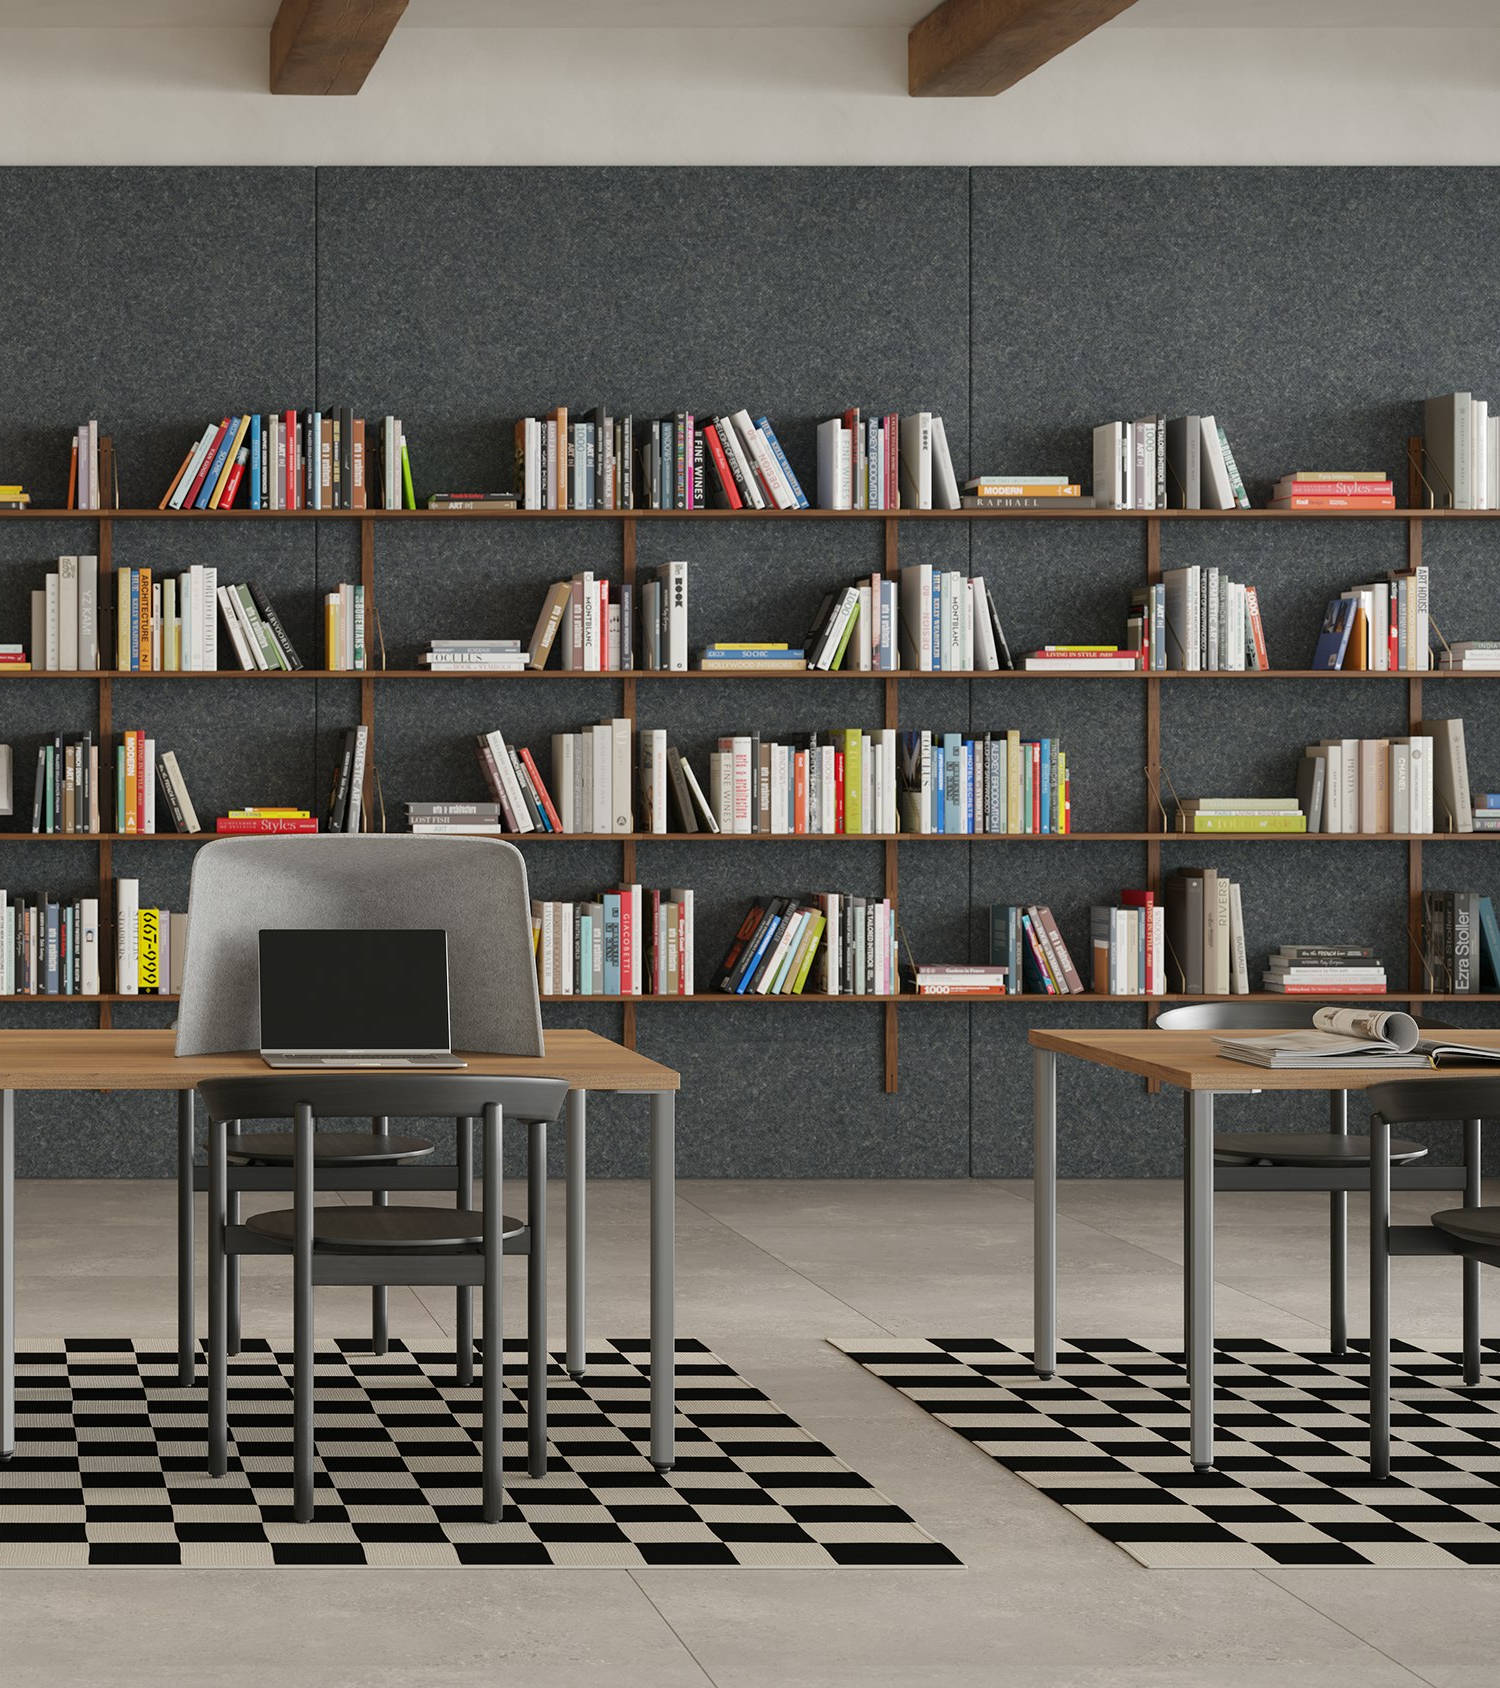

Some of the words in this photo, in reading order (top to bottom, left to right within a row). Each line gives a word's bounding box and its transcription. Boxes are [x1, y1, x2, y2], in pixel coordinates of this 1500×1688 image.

[576, 427, 585, 452] 1000
[869, 419, 877, 450] ALEXEY
[1146, 427, 1155, 453] 1000
[278, 443, 286, 458] ART
[695, 440, 703, 463] FINE
[842, 440, 850, 465] FINE
[1136, 442, 1144, 457] ART
[758, 452, 781, 490] DESIGN
[1223, 444, 1243, 488] BOHEMIANS
[695, 466, 703, 500] WINES
[842, 466, 850, 499] WINES
[984, 486, 1023, 495] MODERN
[1336, 482, 1371, 497] Styles
[977, 498, 1040, 507] RAPHAEL
[1418, 569, 1427, 586] ART
[675, 577, 683, 608] BOOK
[841, 591, 857, 616] 1000
[1209, 573, 1217, 623] DOMESTIC
[1247, 591, 1258, 616] 1000
[1418, 586, 1427, 614] HOUSE
[82, 607, 92, 636] KAMI
[141, 574, 149, 642] ARCHITECTURE
[1157, 603, 1165, 617] ART
[264, 606, 292, 655] VERVOORDT
[355, 604, 364, 649] BOHEMIANS
[922, 612, 930, 651] DESIGN
[1209, 625, 1217, 644] ART
[435, 654, 483, 663] OCULUS
[126, 738, 134, 777] MODERN
[355, 731, 366, 784] DOMESTIC
[66, 766, 74, 781] ART
[724, 764, 732, 787] FINE
[1347, 758, 1355, 794] PRADA
[353, 786, 362, 805] ART
[724, 790, 732, 823] WINES
[261, 819, 296, 831] Styles
[1219, 881, 1227, 927] RIVERS
[545, 934, 552, 945] ON
[1454, 909, 1470, 956] Stoller
[143, 912, 157, 984] 667-999
[1236, 936, 1245, 975] BAUHAUS
[1455, 956, 1470, 990] Ezra
[924, 986, 950, 994] 1000
